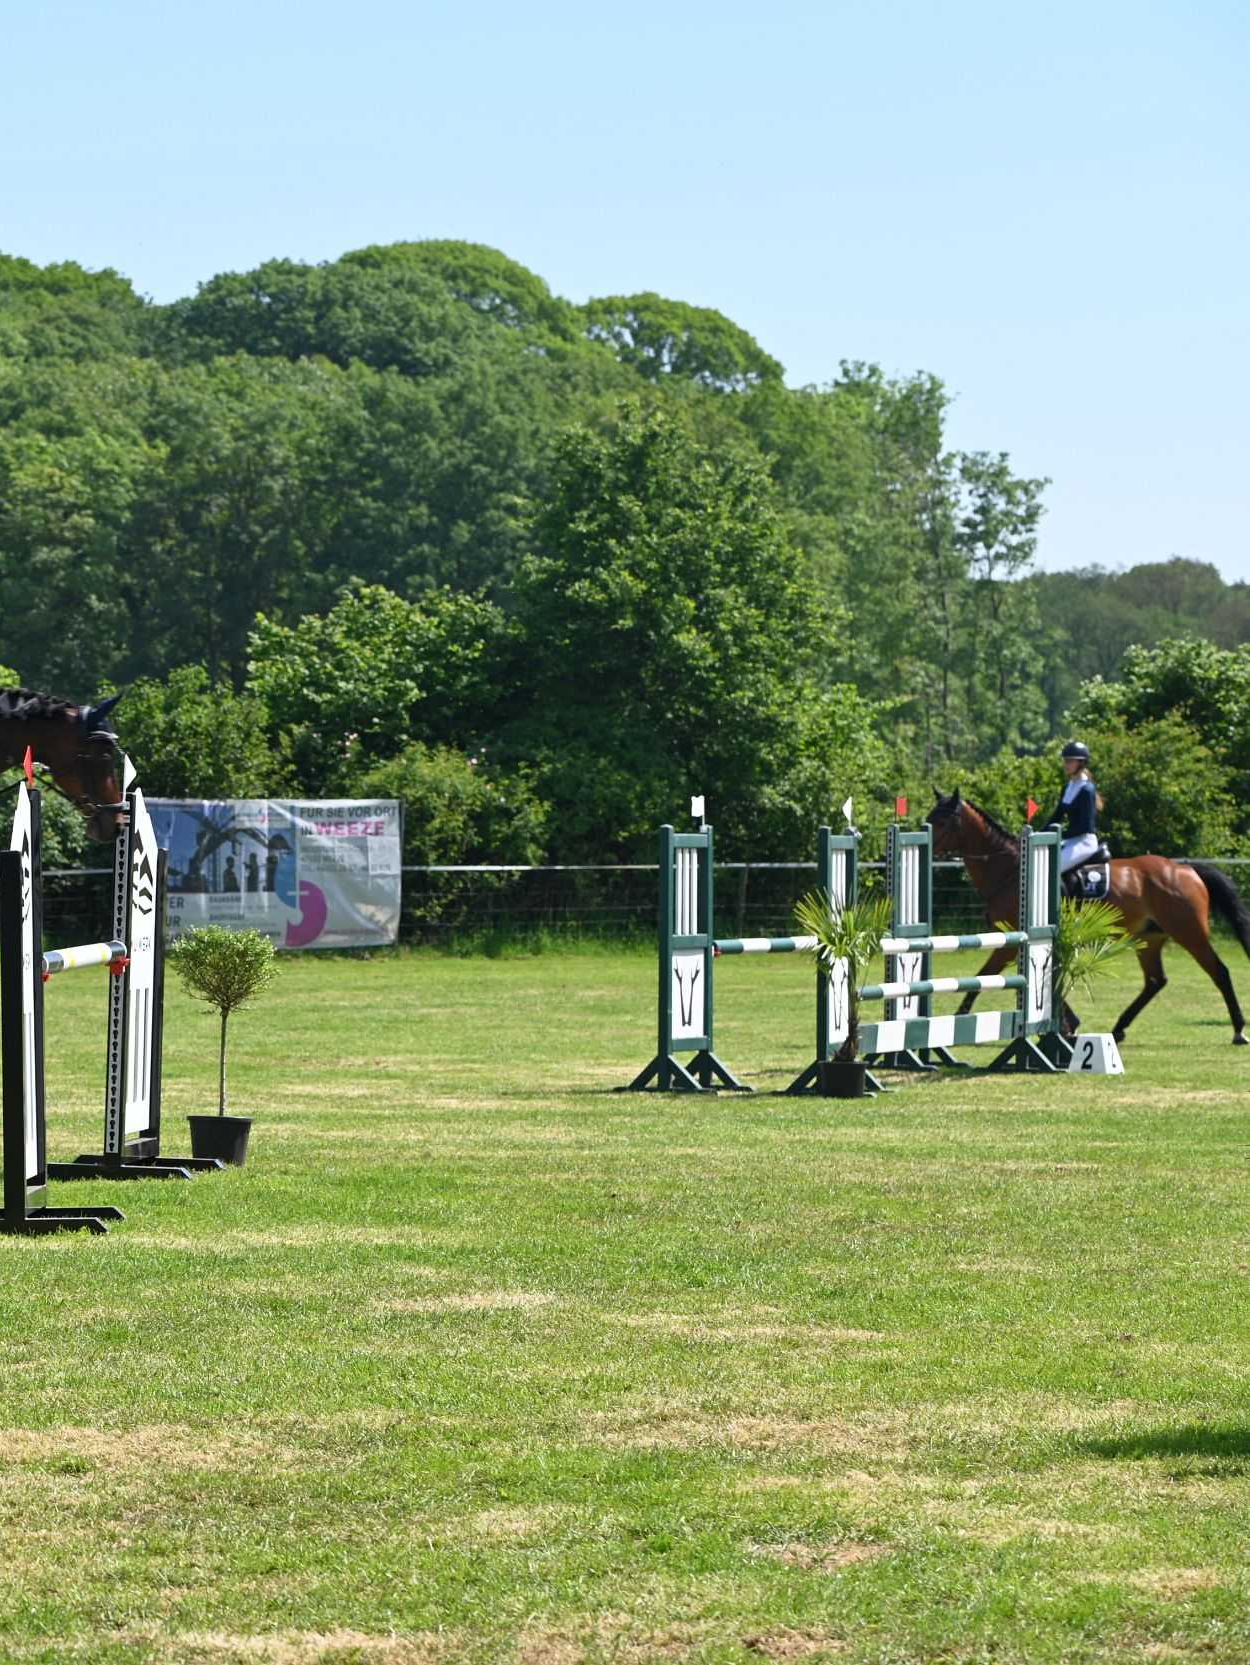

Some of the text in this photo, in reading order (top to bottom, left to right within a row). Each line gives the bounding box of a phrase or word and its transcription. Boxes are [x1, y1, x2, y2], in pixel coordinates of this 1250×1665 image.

[326, 806, 345, 818] SIE
[348, 806, 371, 818] VOR
[374, 805, 397, 817] ORT
[315, 821, 384, 837] WEEZE
[1081, 1041, 1094, 1070] 2
